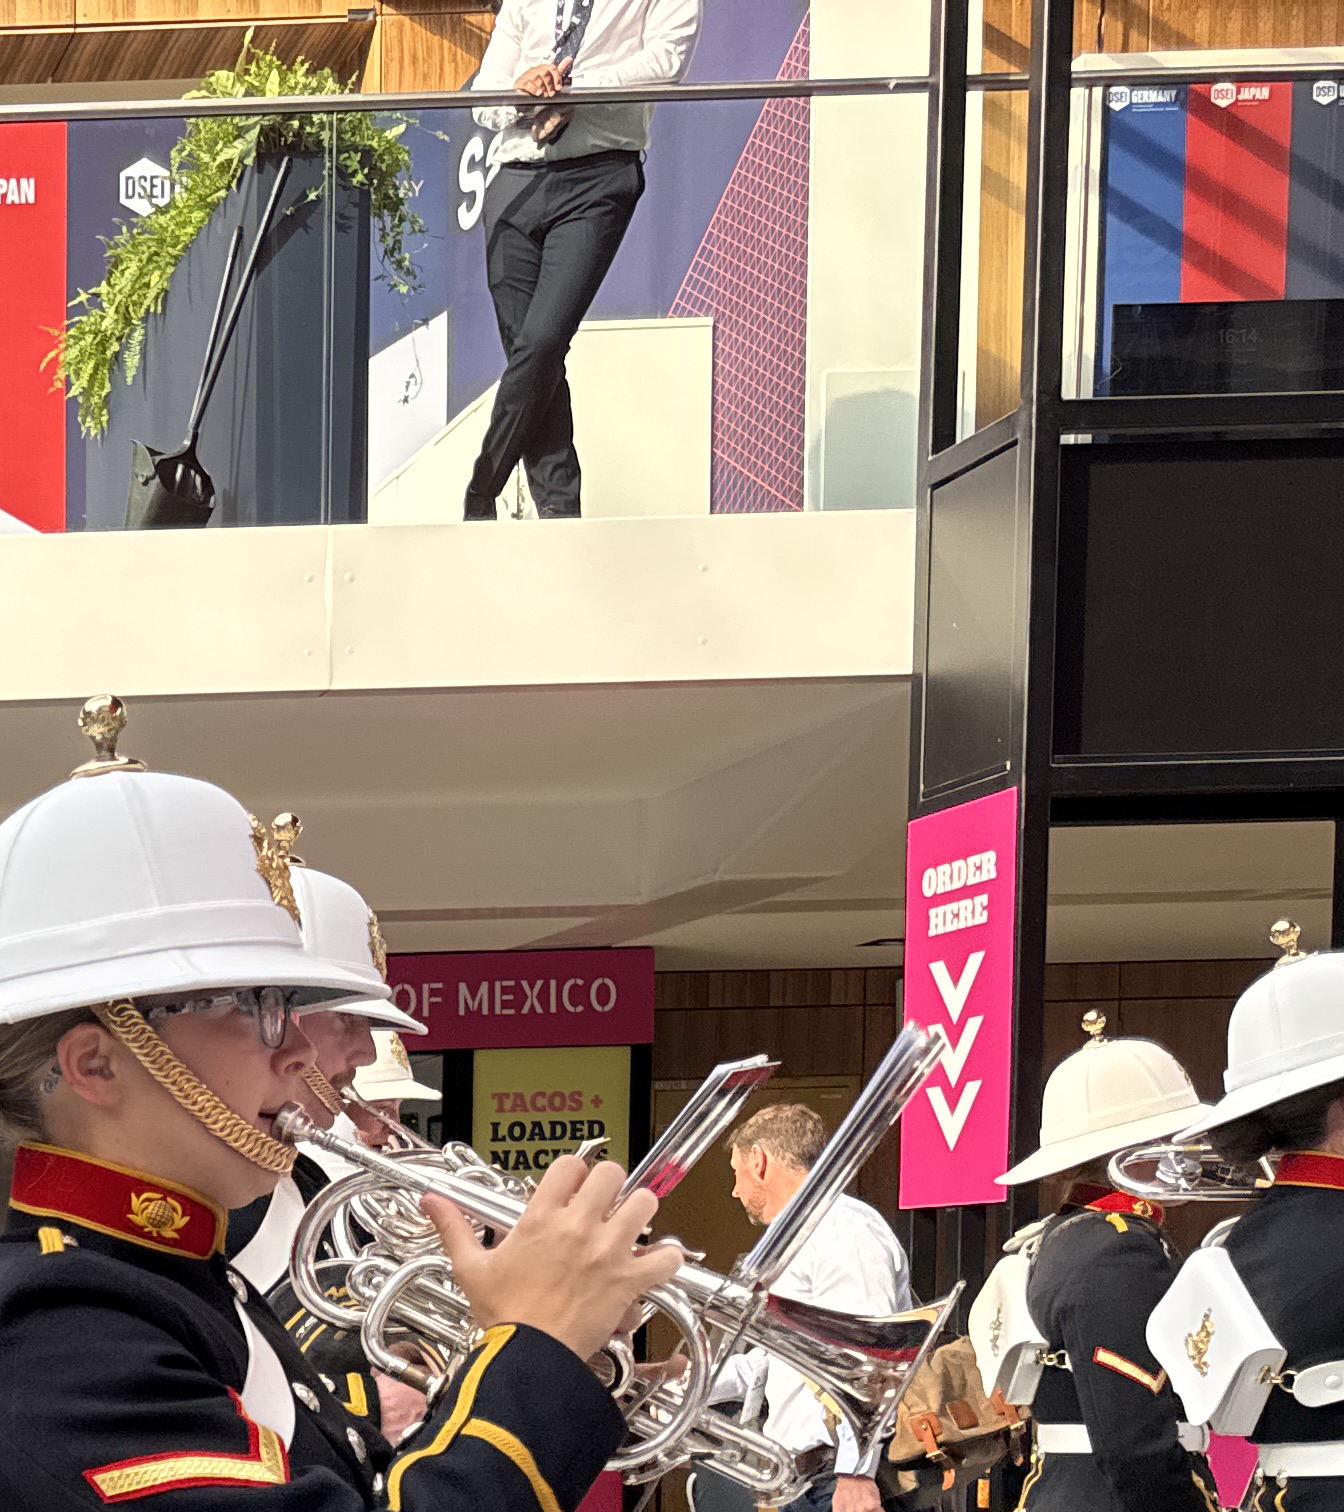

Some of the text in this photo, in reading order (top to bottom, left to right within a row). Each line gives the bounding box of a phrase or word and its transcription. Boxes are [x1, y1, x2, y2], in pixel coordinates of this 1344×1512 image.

[1132, 89, 1177, 103] GERMANY
[1214, 86, 1270, 101] DSEI JAPAN
[124, 174, 165, 200] DSEI
[921, 849, 998, 898] ORDER
[927, 893, 989, 937] HERE
[389, 976, 618, 1018] OF MEXICO
[491, 1090, 583, 1113] TACOS
[489, 1120, 606, 1143] LOADED
